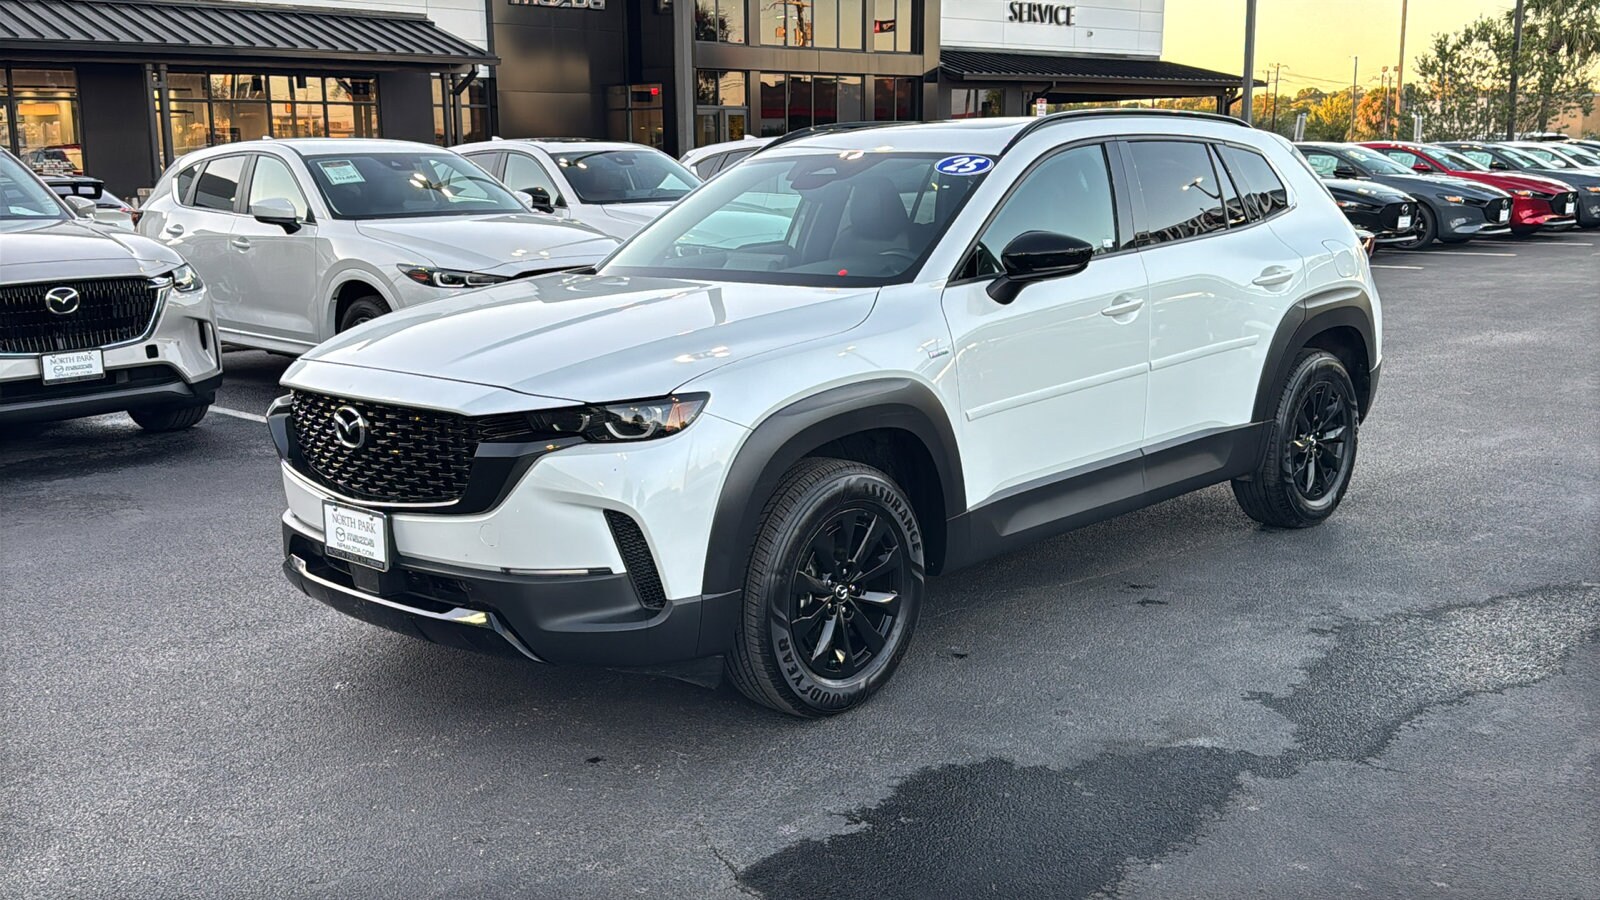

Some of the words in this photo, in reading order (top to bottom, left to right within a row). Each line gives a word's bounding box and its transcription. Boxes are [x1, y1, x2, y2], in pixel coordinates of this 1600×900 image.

[1008, 1, 1076, 26] SERVICE
[942, 157, 986, 172] 25
[50, 356, 75, 365] NORTH
[332, 512, 356, 529] NORTH
[358, 520, 376, 534] PARK
[863, 482, 921, 553] ASSURANCE
[778, 636, 849, 704] GOODYEAR
